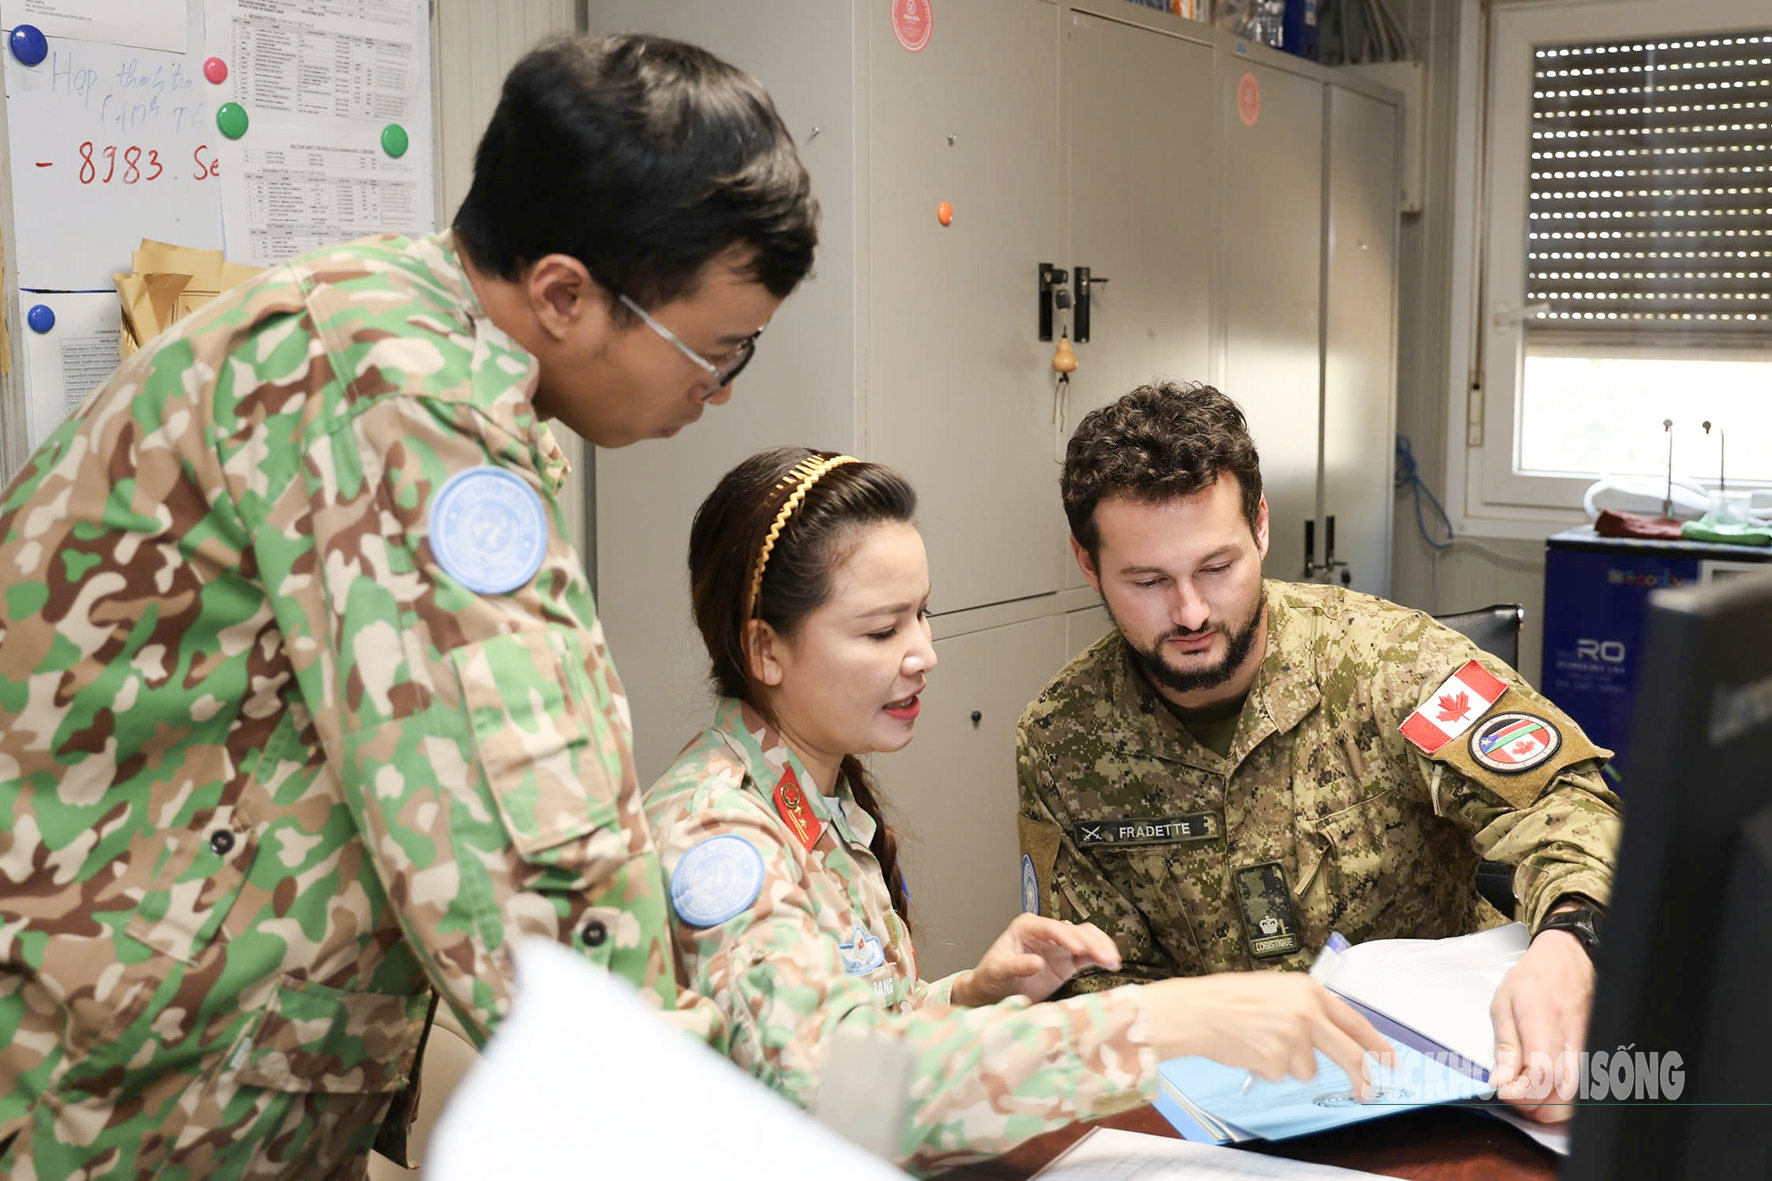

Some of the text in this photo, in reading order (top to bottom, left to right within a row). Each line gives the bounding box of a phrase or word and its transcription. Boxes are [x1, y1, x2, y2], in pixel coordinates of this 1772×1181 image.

[1577, 638, 1626, 663] RO
[1119, 823, 1191, 839] FRADETTE
[1255, 937, 1293, 952] LOGISTIQUE
